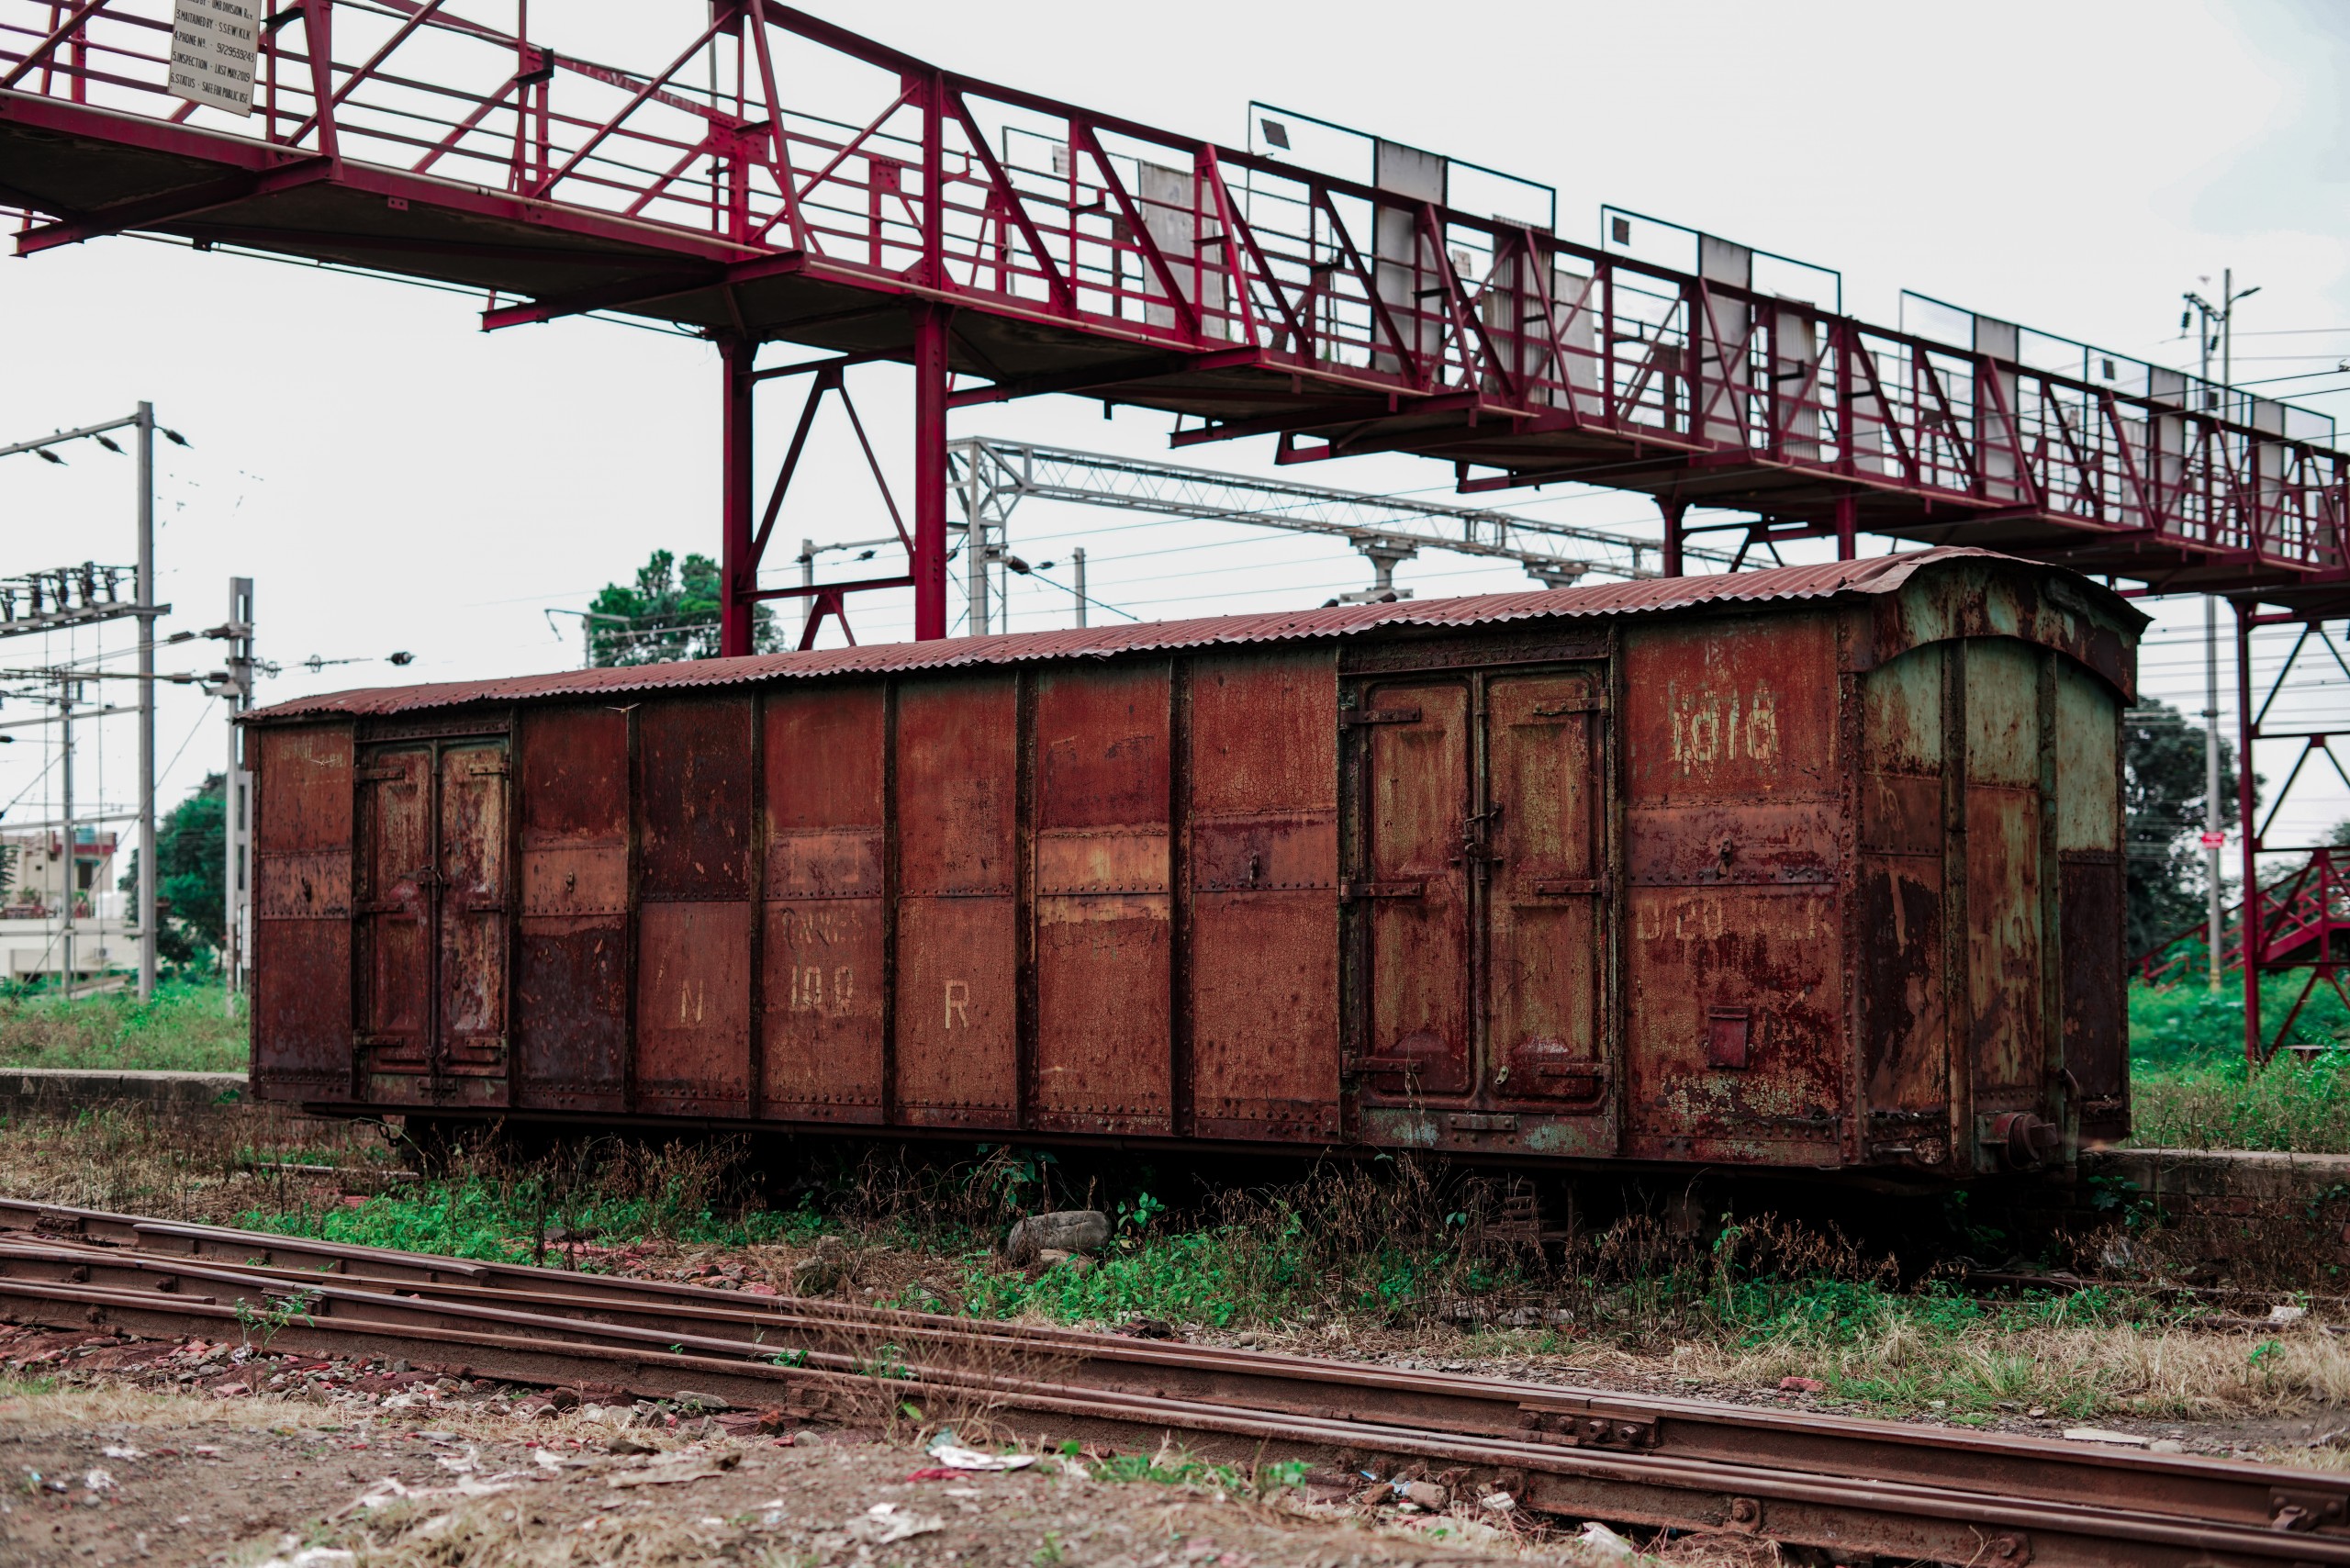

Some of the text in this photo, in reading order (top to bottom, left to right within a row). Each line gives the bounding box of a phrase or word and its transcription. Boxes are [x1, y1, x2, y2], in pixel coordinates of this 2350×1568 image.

[222, 4, 242, 17] DIVISION
[206, 18, 213, 29] BY
[586, 66, 635, 89] LOVE
[202, 82, 214, 93] SAFE
[222, 88, 239, 101] PUBLIC
[240, 94, 248, 104] USE
[680, 980, 704, 1025] N
[944, 979, 971, 1029] R
